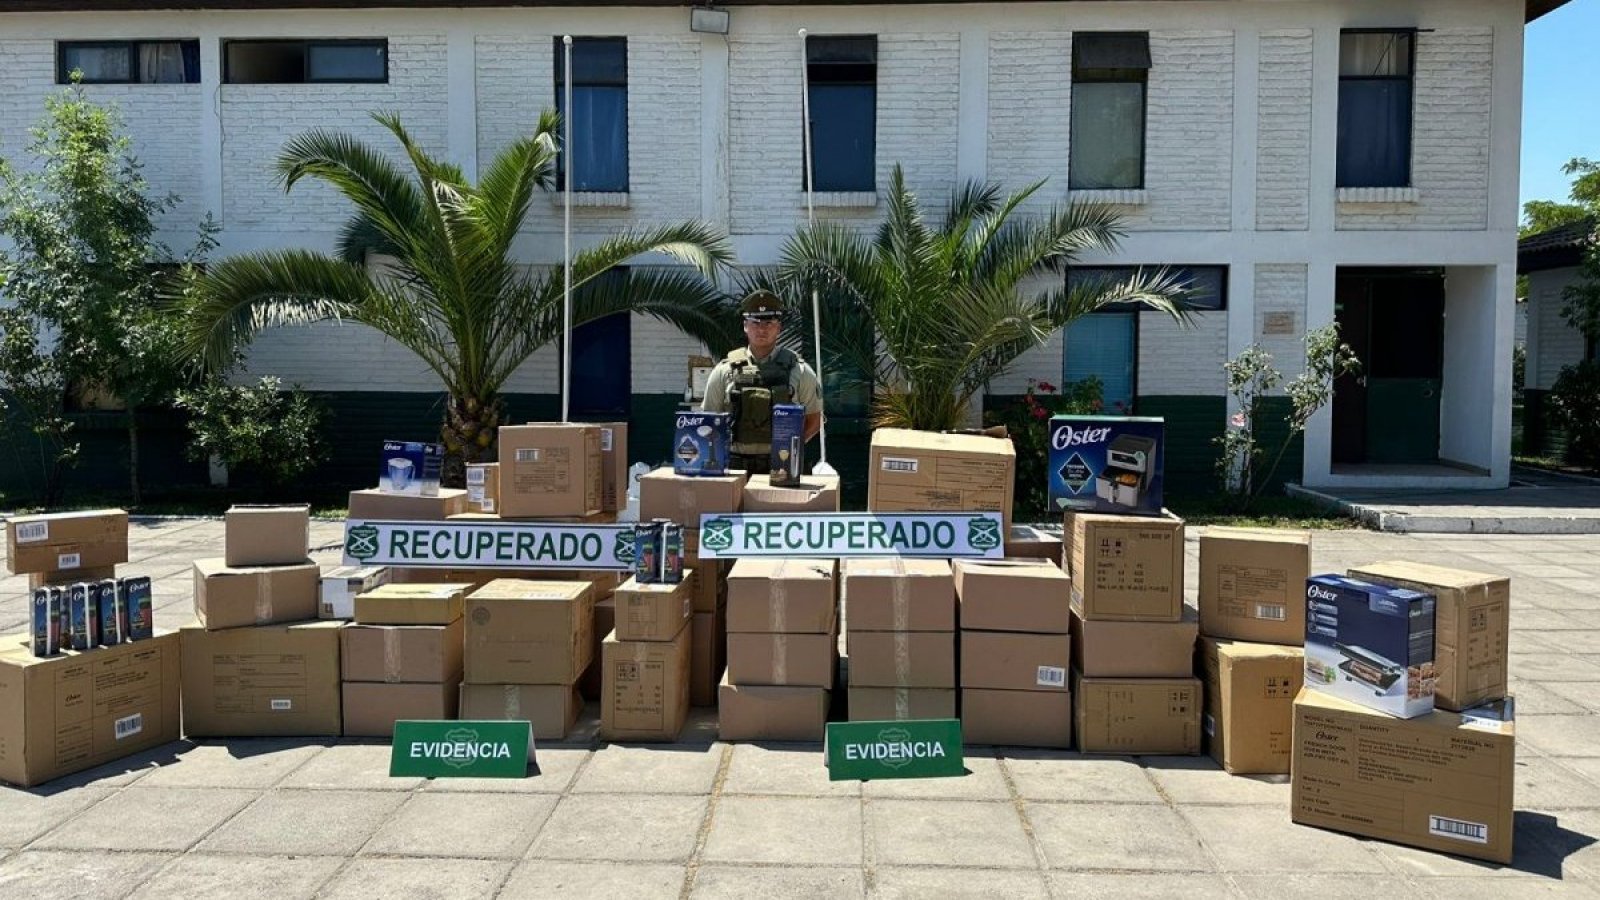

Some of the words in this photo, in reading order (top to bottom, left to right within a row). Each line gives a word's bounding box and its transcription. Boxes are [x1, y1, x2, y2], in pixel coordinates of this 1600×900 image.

[676, 415, 705, 429] Oster
[1052, 425, 1112, 450] Oster
[743, 520, 956, 550] RECUPERADO
[389, 529, 603, 561] RECUPERADO
[1307, 584, 1338, 601] Oster
[410, 742, 511, 758] EVIDENCIA
[845, 741, 945, 760] EVIDENCIA
